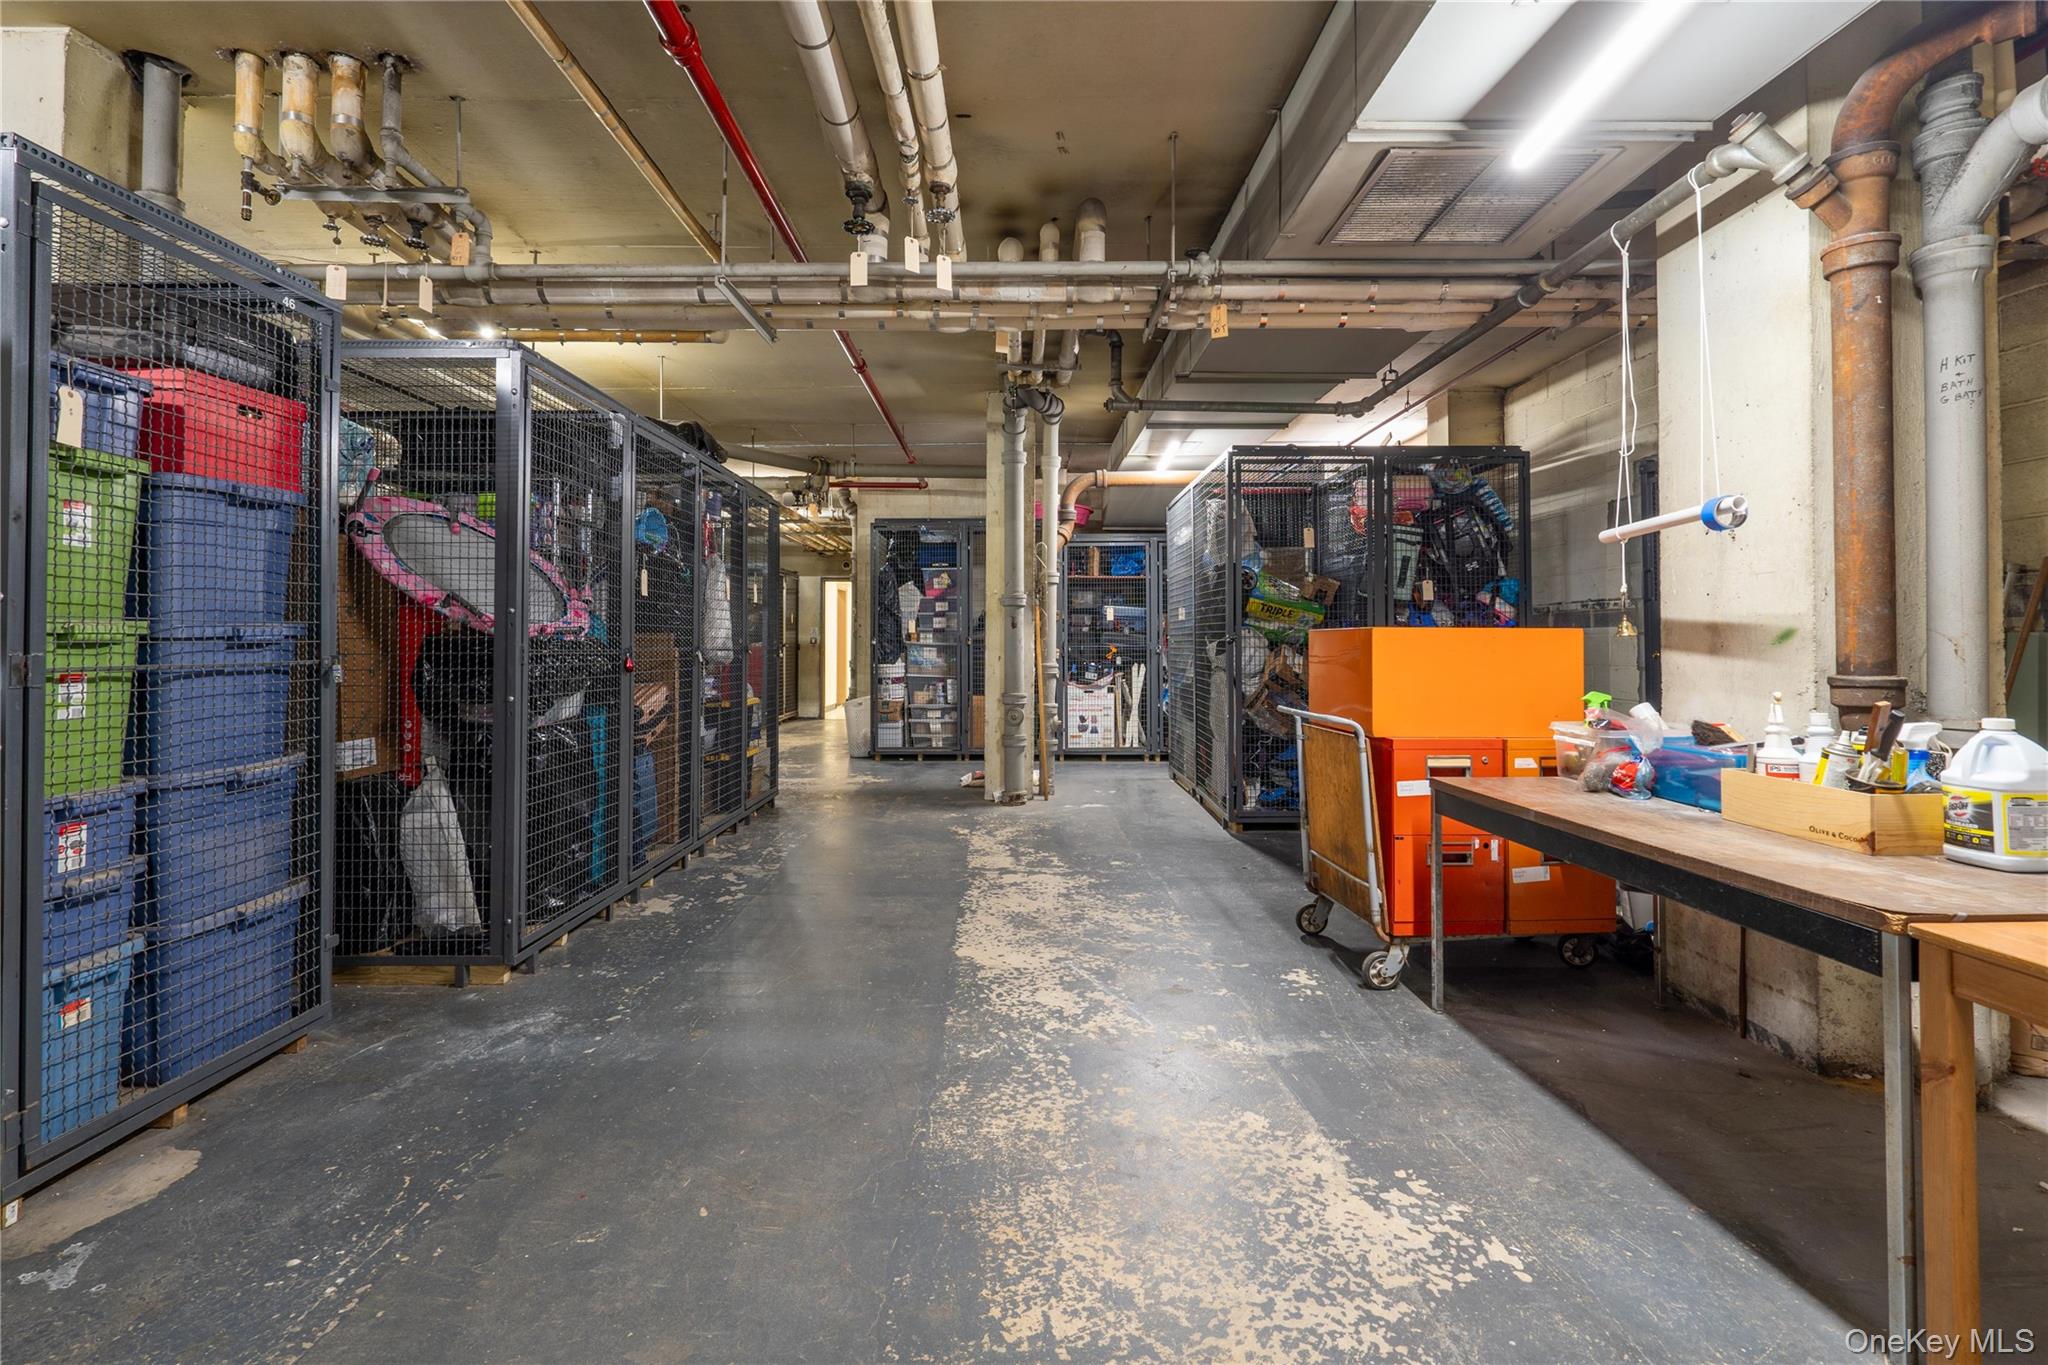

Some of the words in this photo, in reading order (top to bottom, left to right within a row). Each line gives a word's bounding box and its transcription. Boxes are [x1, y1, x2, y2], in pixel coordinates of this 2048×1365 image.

[282, 296, 296, 310] 46
[1940, 356, 1949, 373] H
[1940, 378, 1974, 393] BATH
[1260, 602, 1295, 617] TRIPLE
[1808, 825, 1829, 837] OLIVE
